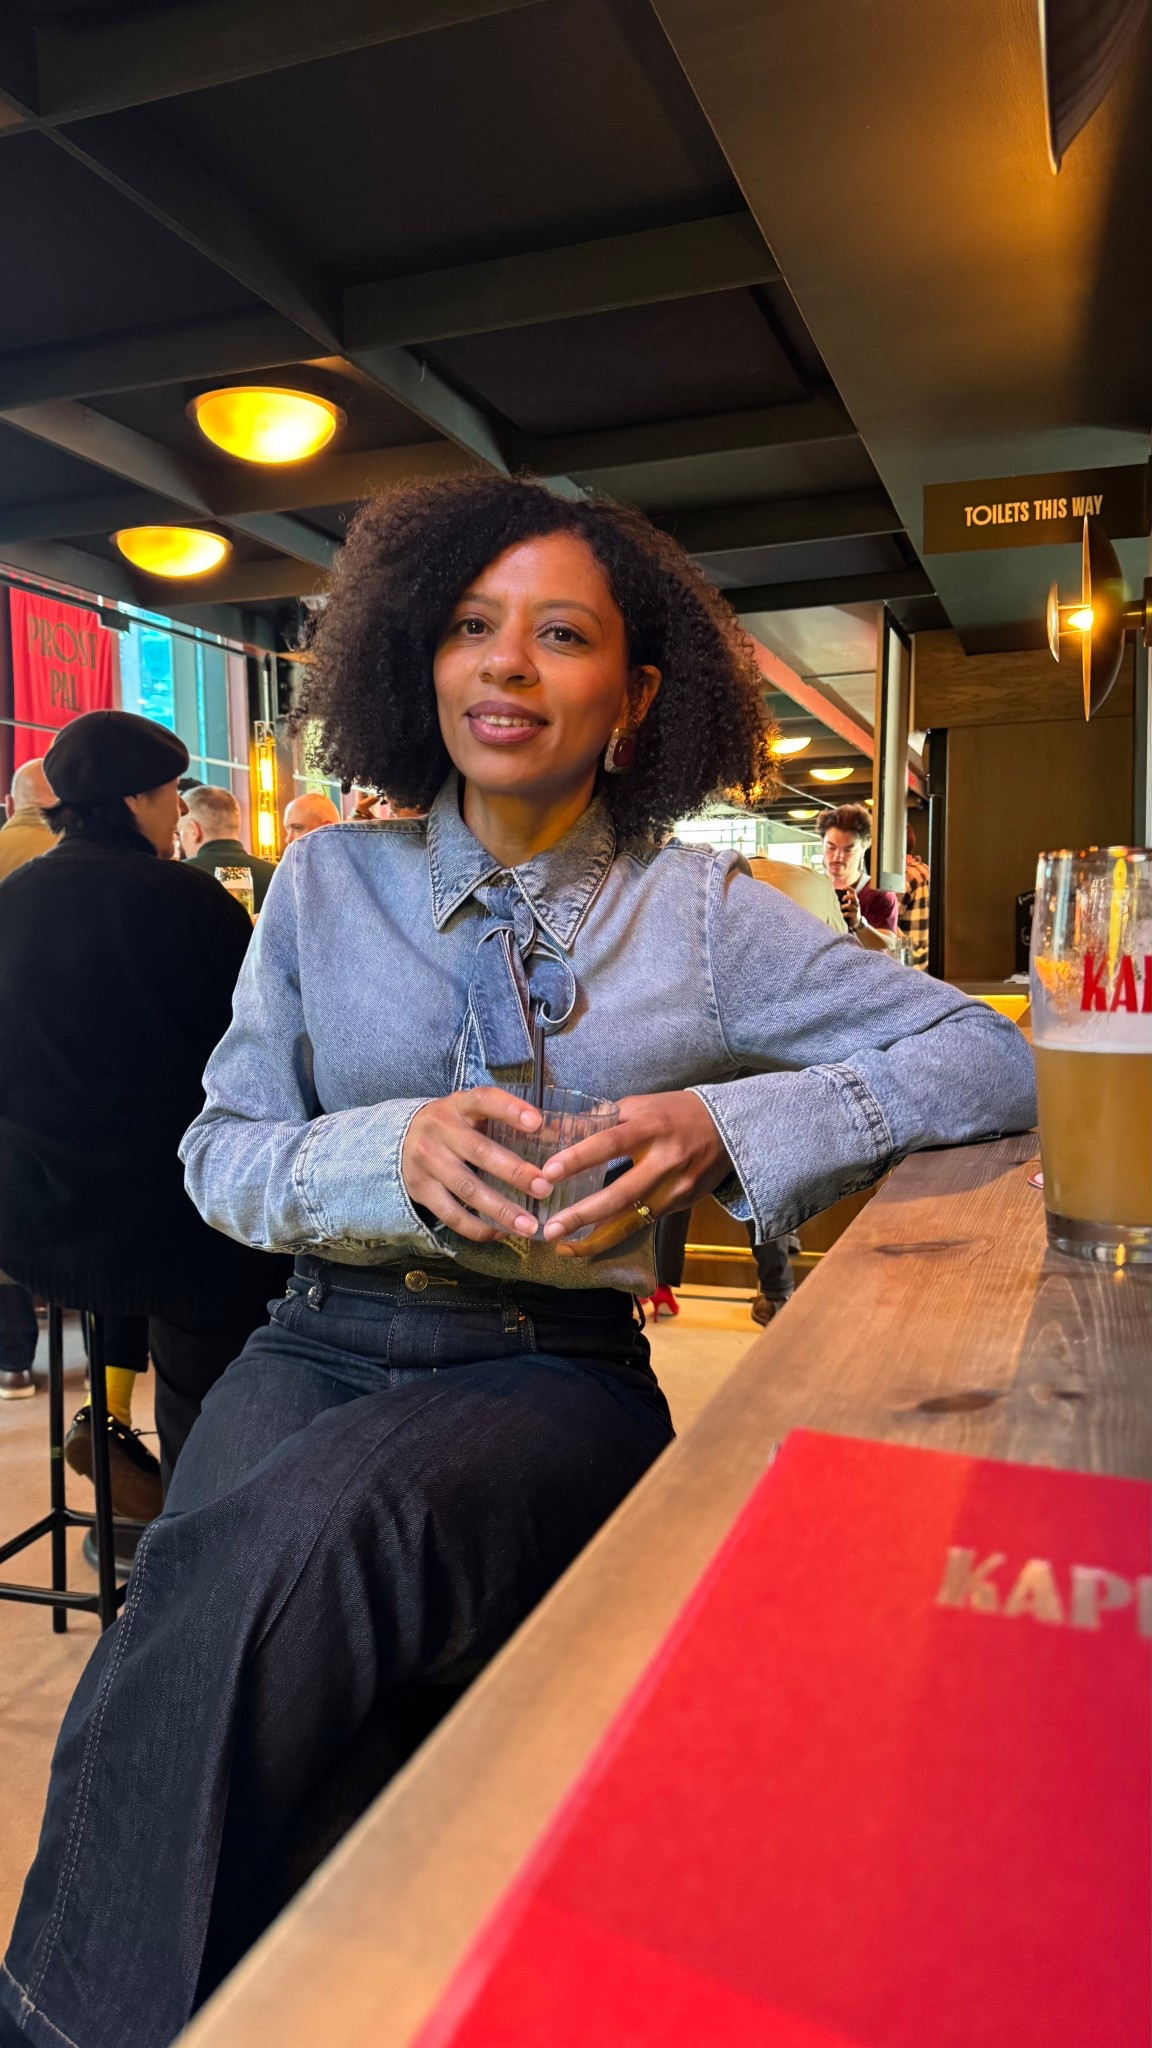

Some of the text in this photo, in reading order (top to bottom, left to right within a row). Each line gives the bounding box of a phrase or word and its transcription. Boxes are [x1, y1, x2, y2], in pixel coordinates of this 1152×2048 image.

[965, 495, 1103, 527] TOILETS THIS WAY
[28, 614, 97, 670] PROST
[50, 669, 81, 712] PAL
